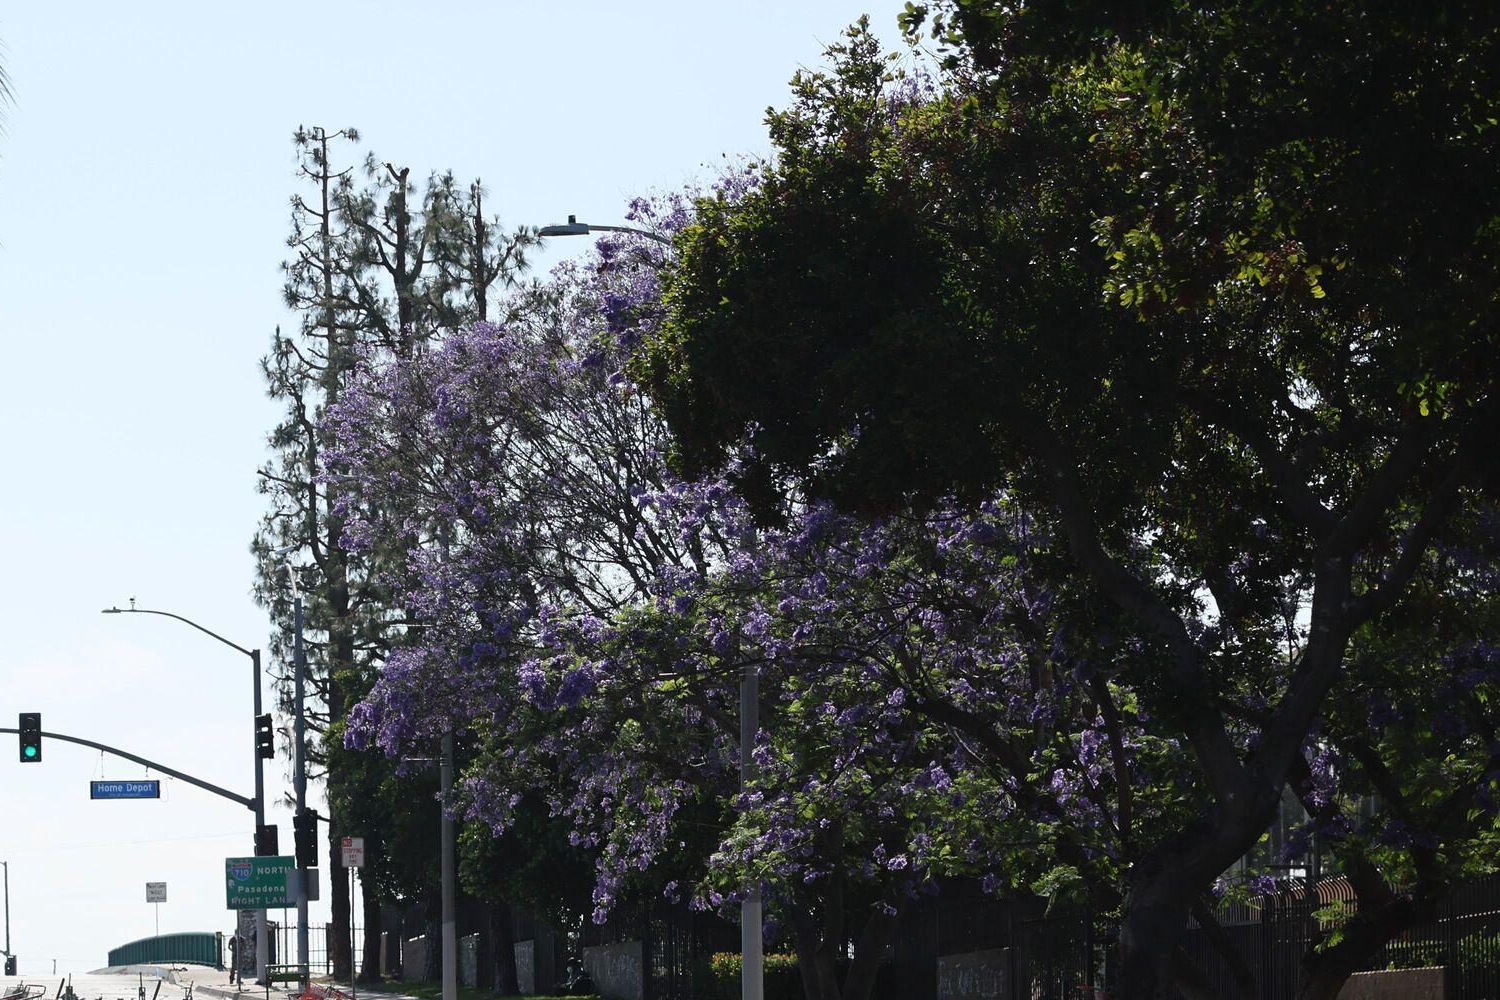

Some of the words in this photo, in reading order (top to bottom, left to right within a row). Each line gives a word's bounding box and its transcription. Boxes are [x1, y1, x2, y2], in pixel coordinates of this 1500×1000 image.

[97, 784, 123, 793] Home
[126, 783, 153, 793] Depot
[235, 868, 249, 876] 710
[257, 866, 291, 875] NORT
[237, 885, 285, 893] Pasadena
[231, 897, 261, 905] RIGHT
